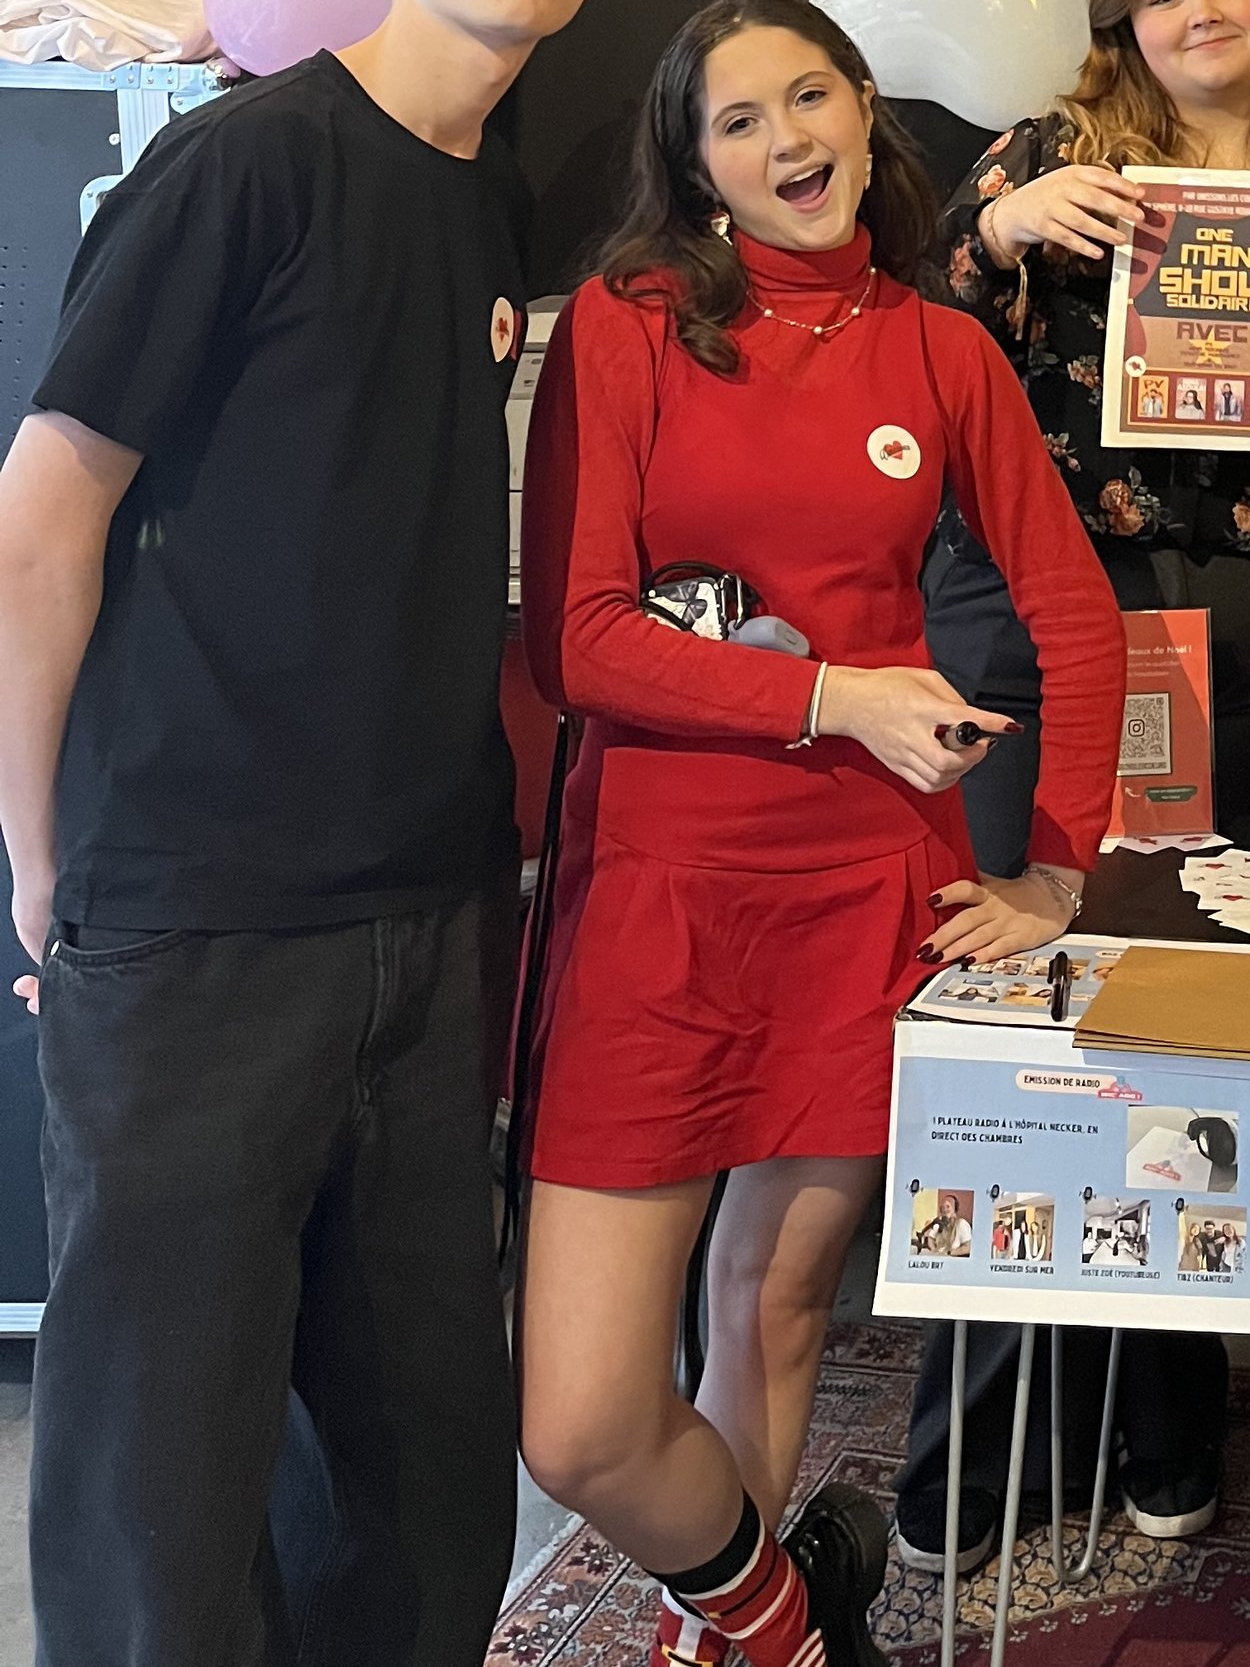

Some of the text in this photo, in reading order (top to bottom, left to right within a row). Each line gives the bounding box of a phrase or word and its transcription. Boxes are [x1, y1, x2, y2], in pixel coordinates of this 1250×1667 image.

[1196, 227, 1234, 242] ONE
[1176, 321, 1248, 343] AVEC
[1127, 645, 1151, 655] eaux
[1153, 645, 1165, 655] de
[1024, 1075, 1101, 1089] EMISSION DE RADIO
[937, 1116, 974, 1127] PLATEAU
[975, 1118, 1000, 1128] RADIO
[1087, 1125, 1099, 1135] EN
[931, 1131, 1023, 1145] DIRECT DES CHAMBRES
[990, 1264, 1055, 1275] VENDREDI SUR MER
[1193, 1273, 1234, 1284] (CHANTEUR)
